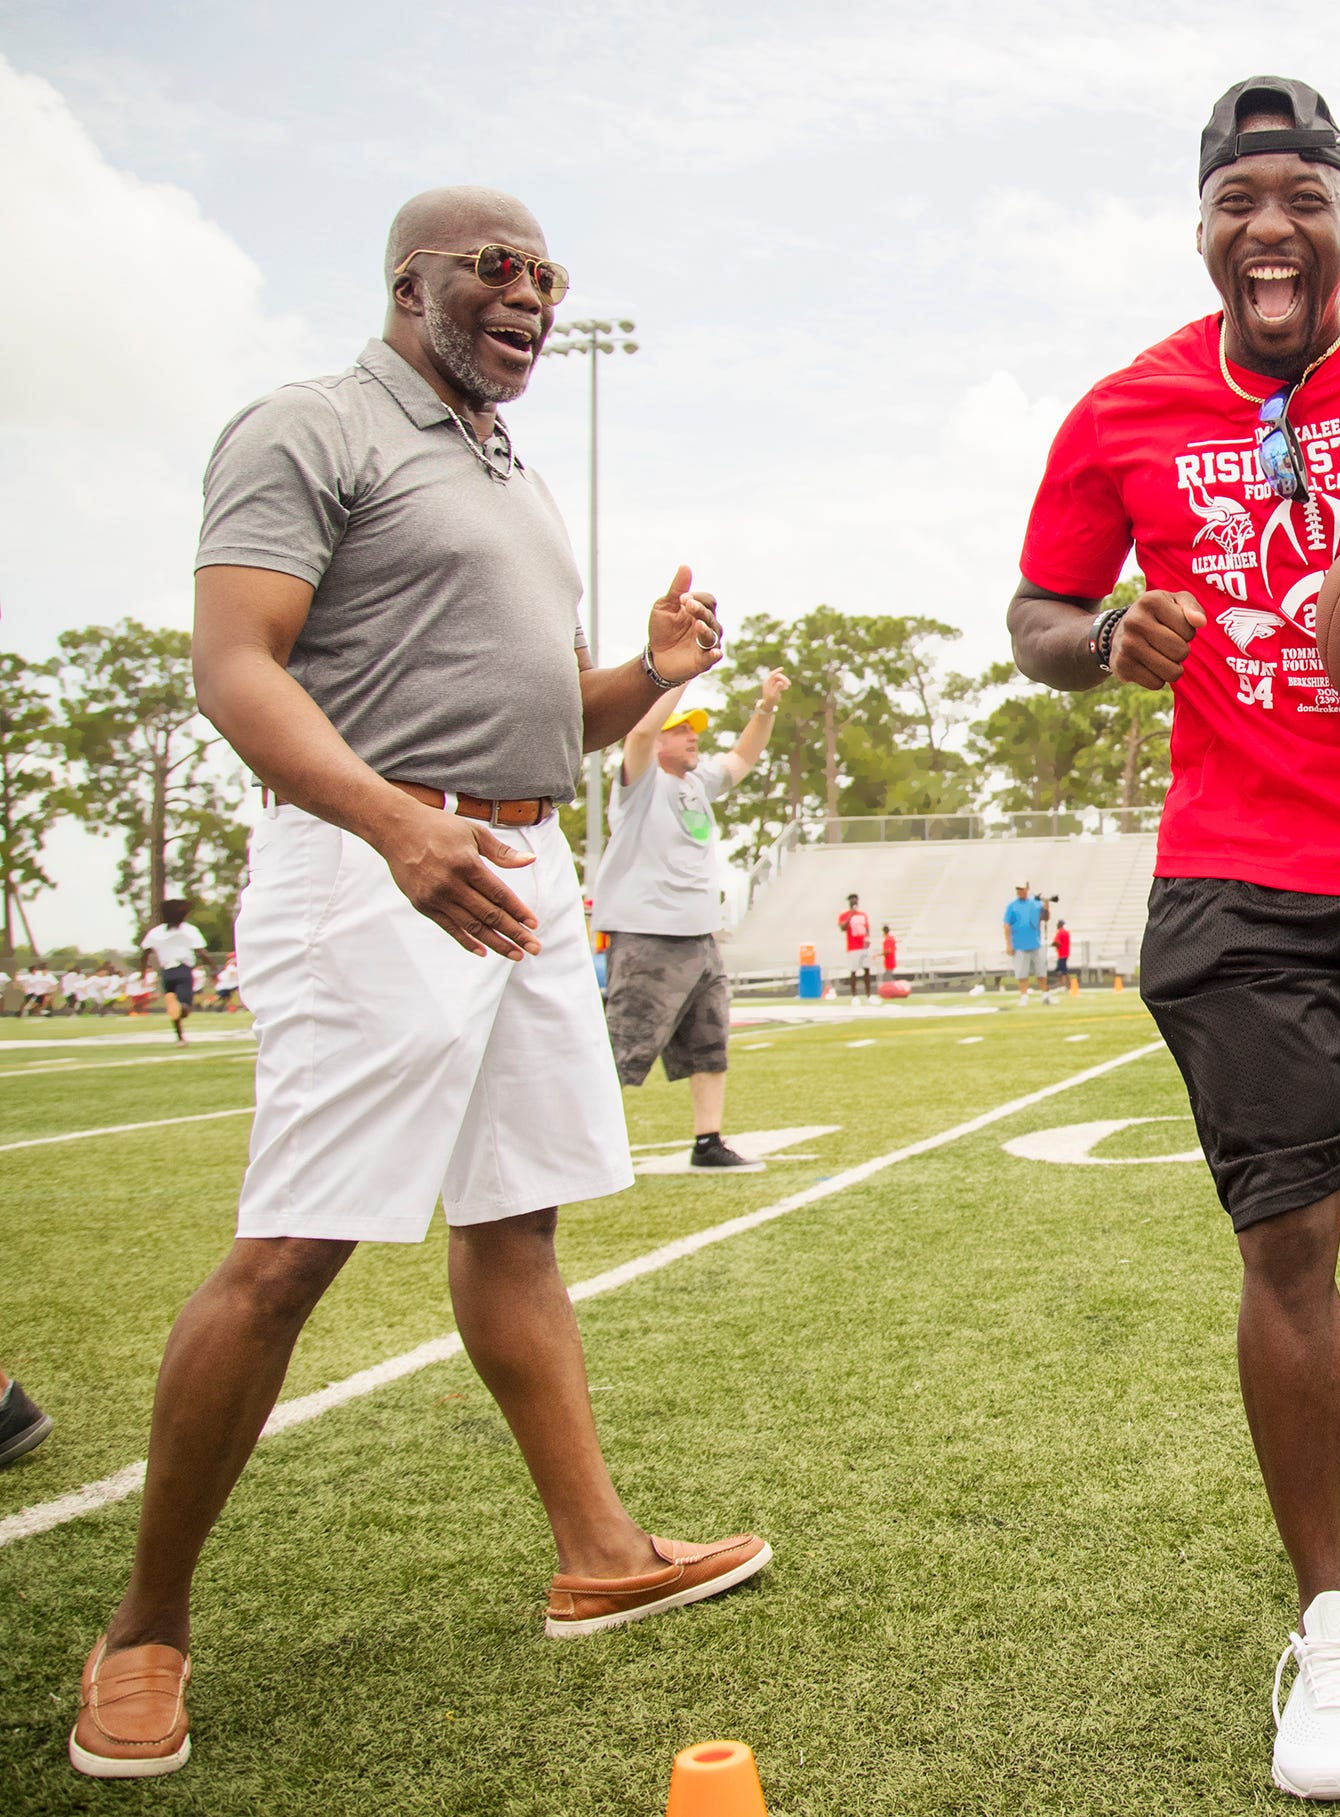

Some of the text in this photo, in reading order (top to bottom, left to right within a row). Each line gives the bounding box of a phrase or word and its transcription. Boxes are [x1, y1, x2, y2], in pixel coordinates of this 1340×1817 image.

[1192, 551, 1258, 574] ALEXANDER
[1287, 676, 1330, 688] BERKSHIRE
[1236, 673, 1274, 709] 94
[1316, 688, 1339, 697] DON
